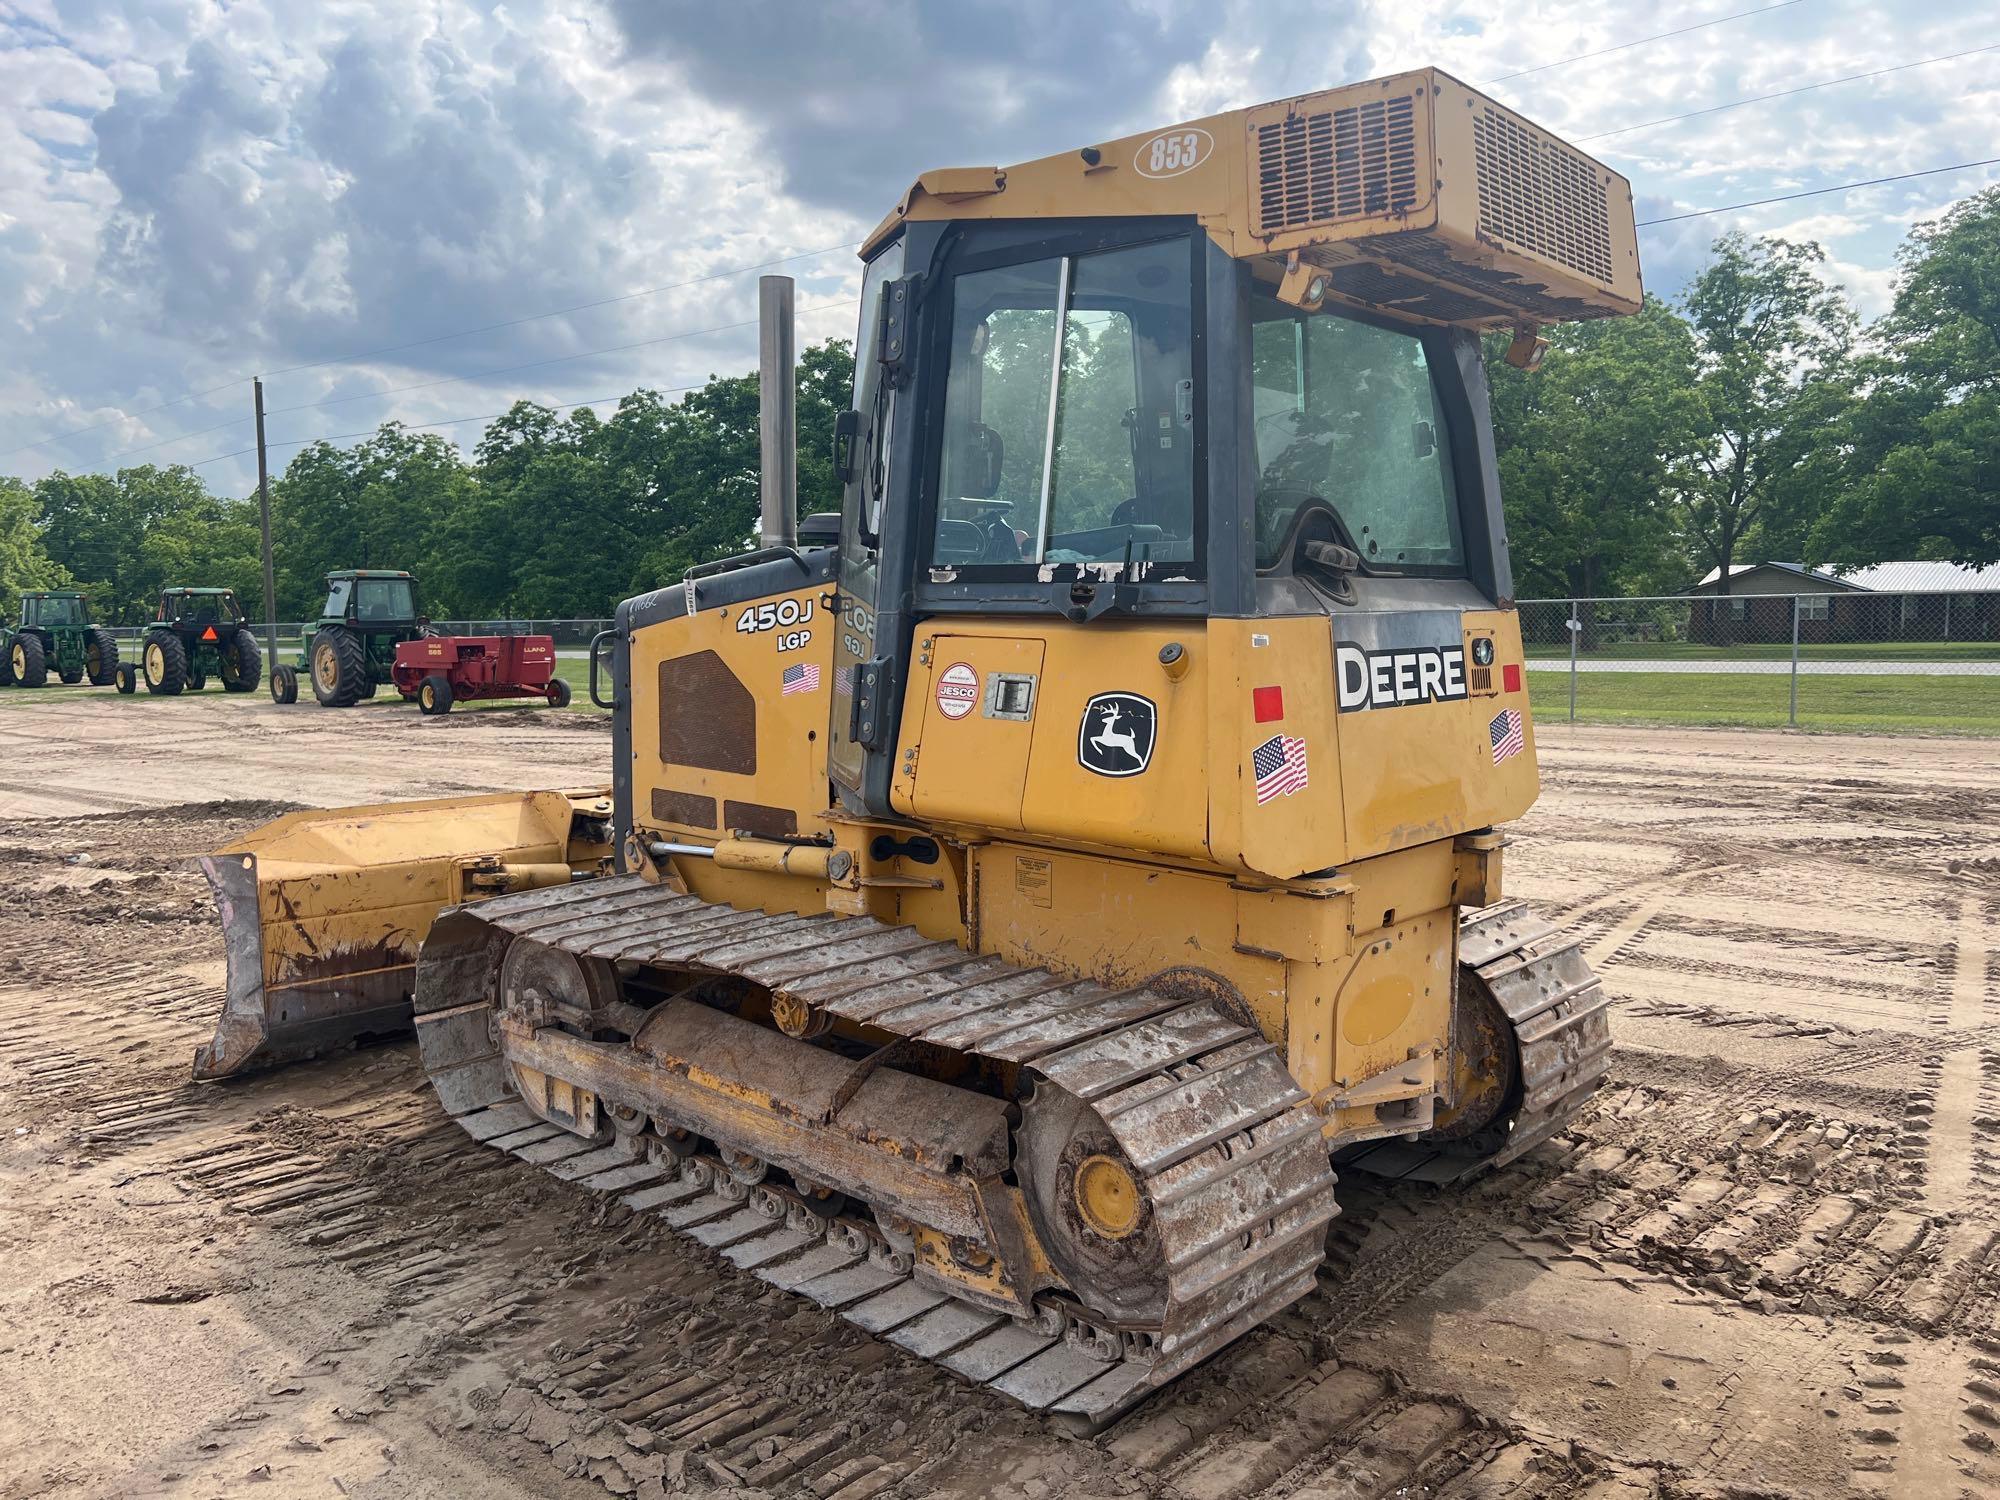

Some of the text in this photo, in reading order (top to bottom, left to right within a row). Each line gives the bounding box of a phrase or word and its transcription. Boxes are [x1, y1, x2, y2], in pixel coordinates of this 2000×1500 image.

[1150, 133, 1198, 172] 853
[736, 599, 814, 634] 450J
[777, 630, 812, 652] LGP
[940, 686, 976, 698] JESCO
[1336, 645, 1467, 708] DEERE
